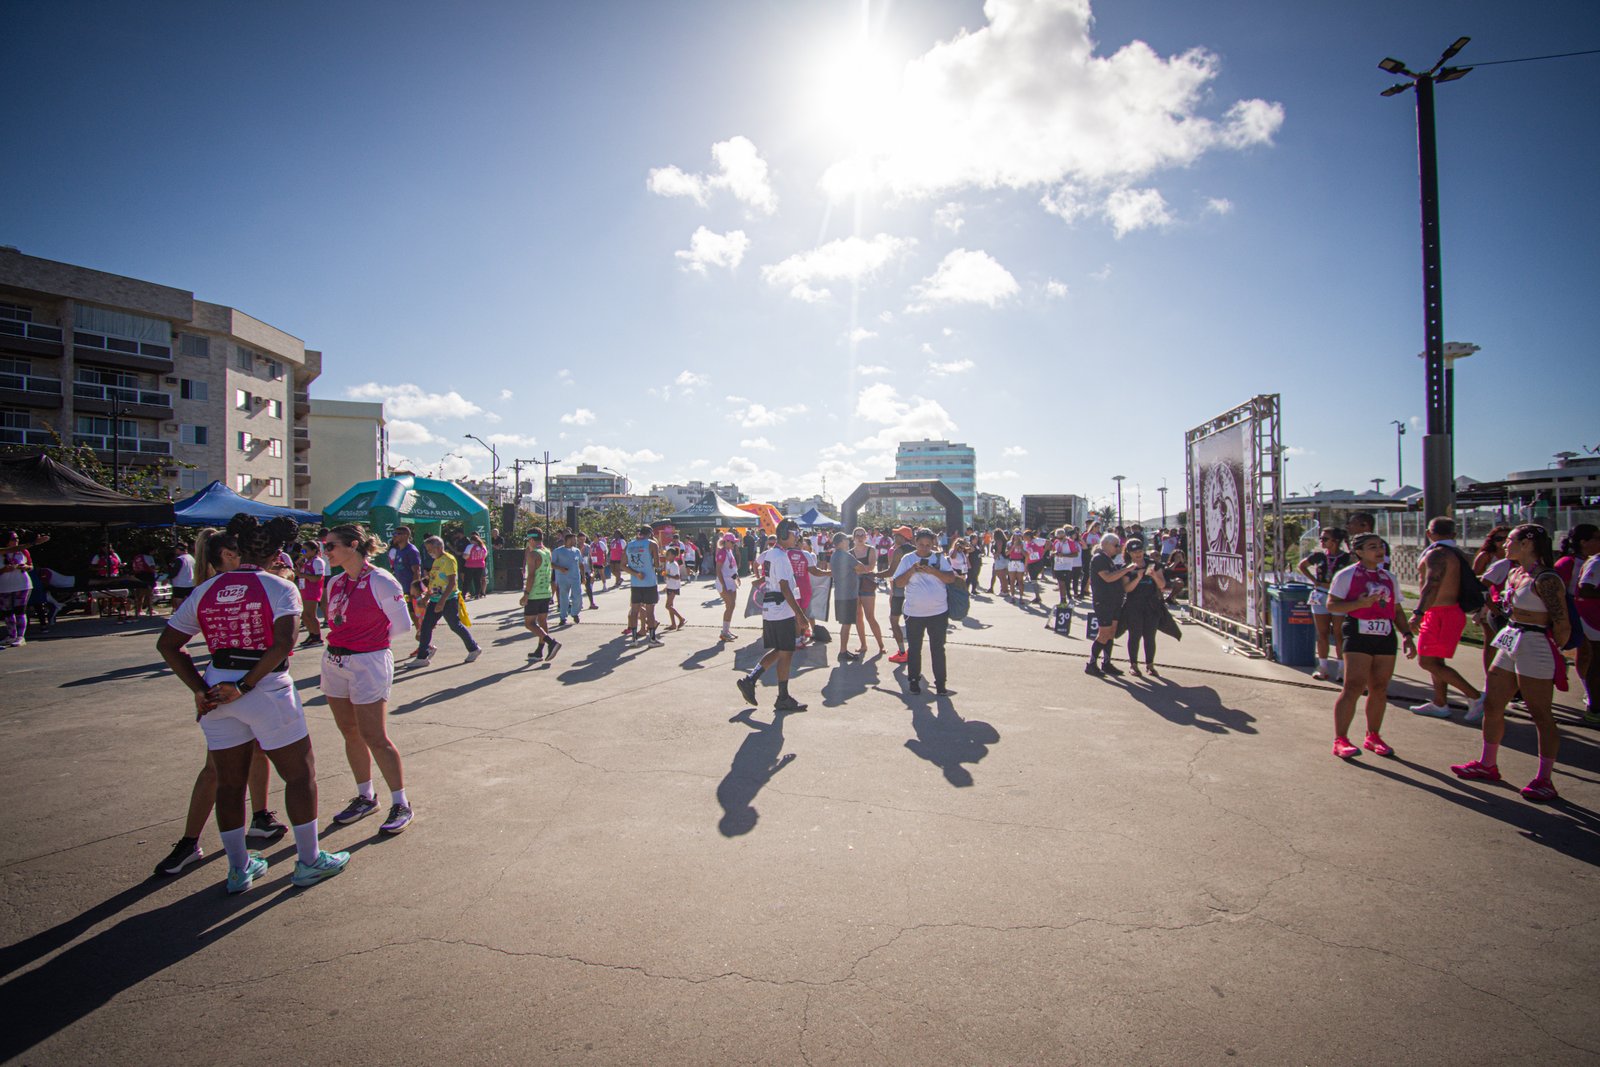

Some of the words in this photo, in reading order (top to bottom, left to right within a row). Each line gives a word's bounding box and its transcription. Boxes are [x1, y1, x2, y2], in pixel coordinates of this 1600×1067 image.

[1206, 555, 1243, 584] ESPARTANAS
[1090, 617, 1099, 630] 5
[1367, 620, 1386, 631] 377
[1498, 634, 1514, 647] 403
